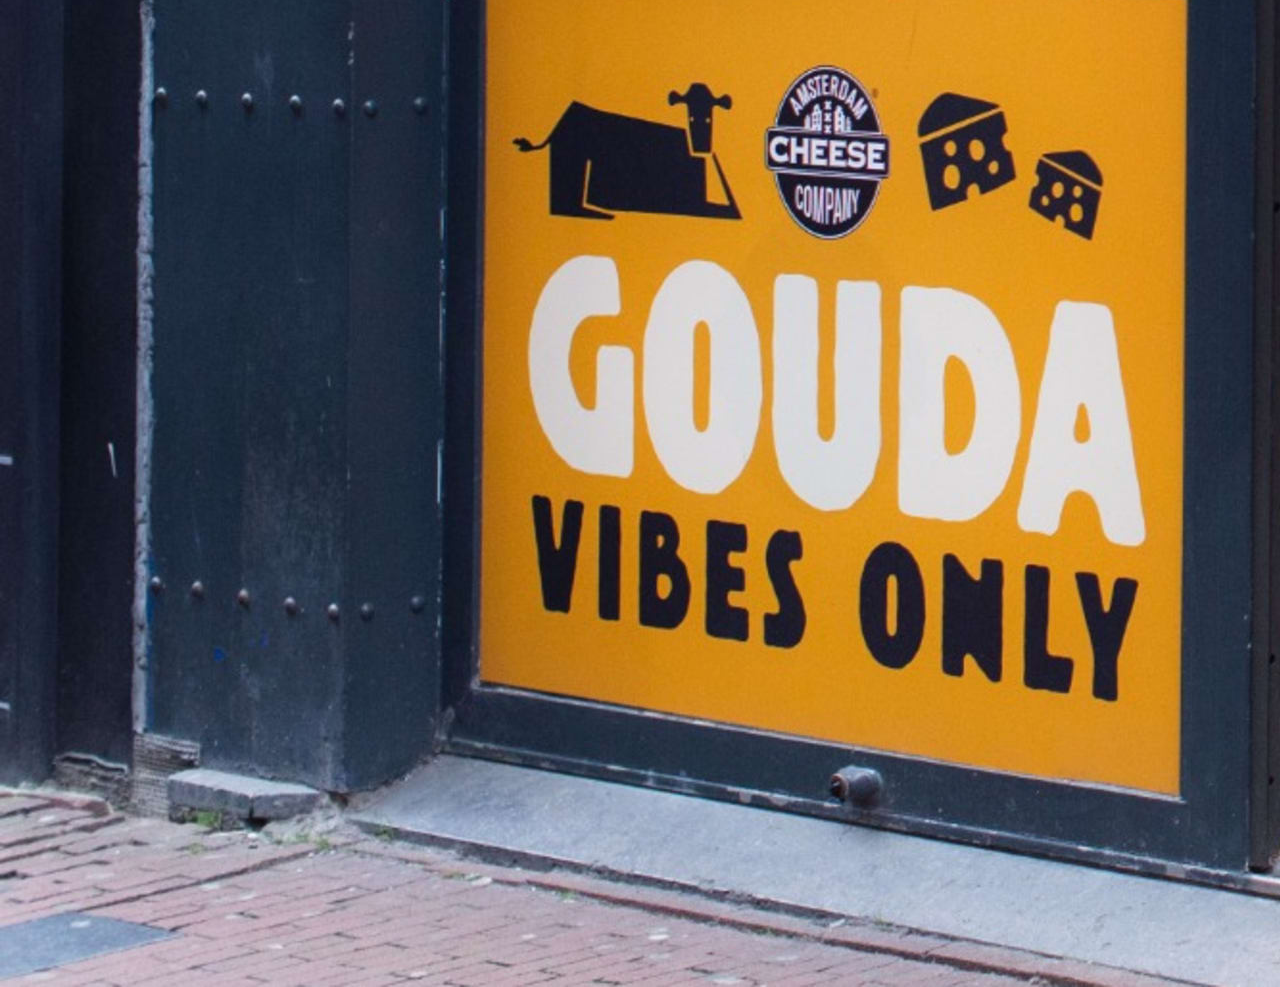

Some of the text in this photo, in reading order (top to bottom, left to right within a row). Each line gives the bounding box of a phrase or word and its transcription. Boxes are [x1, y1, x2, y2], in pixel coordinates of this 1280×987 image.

[789, 74, 869, 121] AMSTERDAM
[769, 135, 886, 171] CHEESE
[794, 185, 861, 225] COMPANY
[528, 255, 1146, 547] GOUDA
[531, 495, 1139, 702] VIBES ONLY
